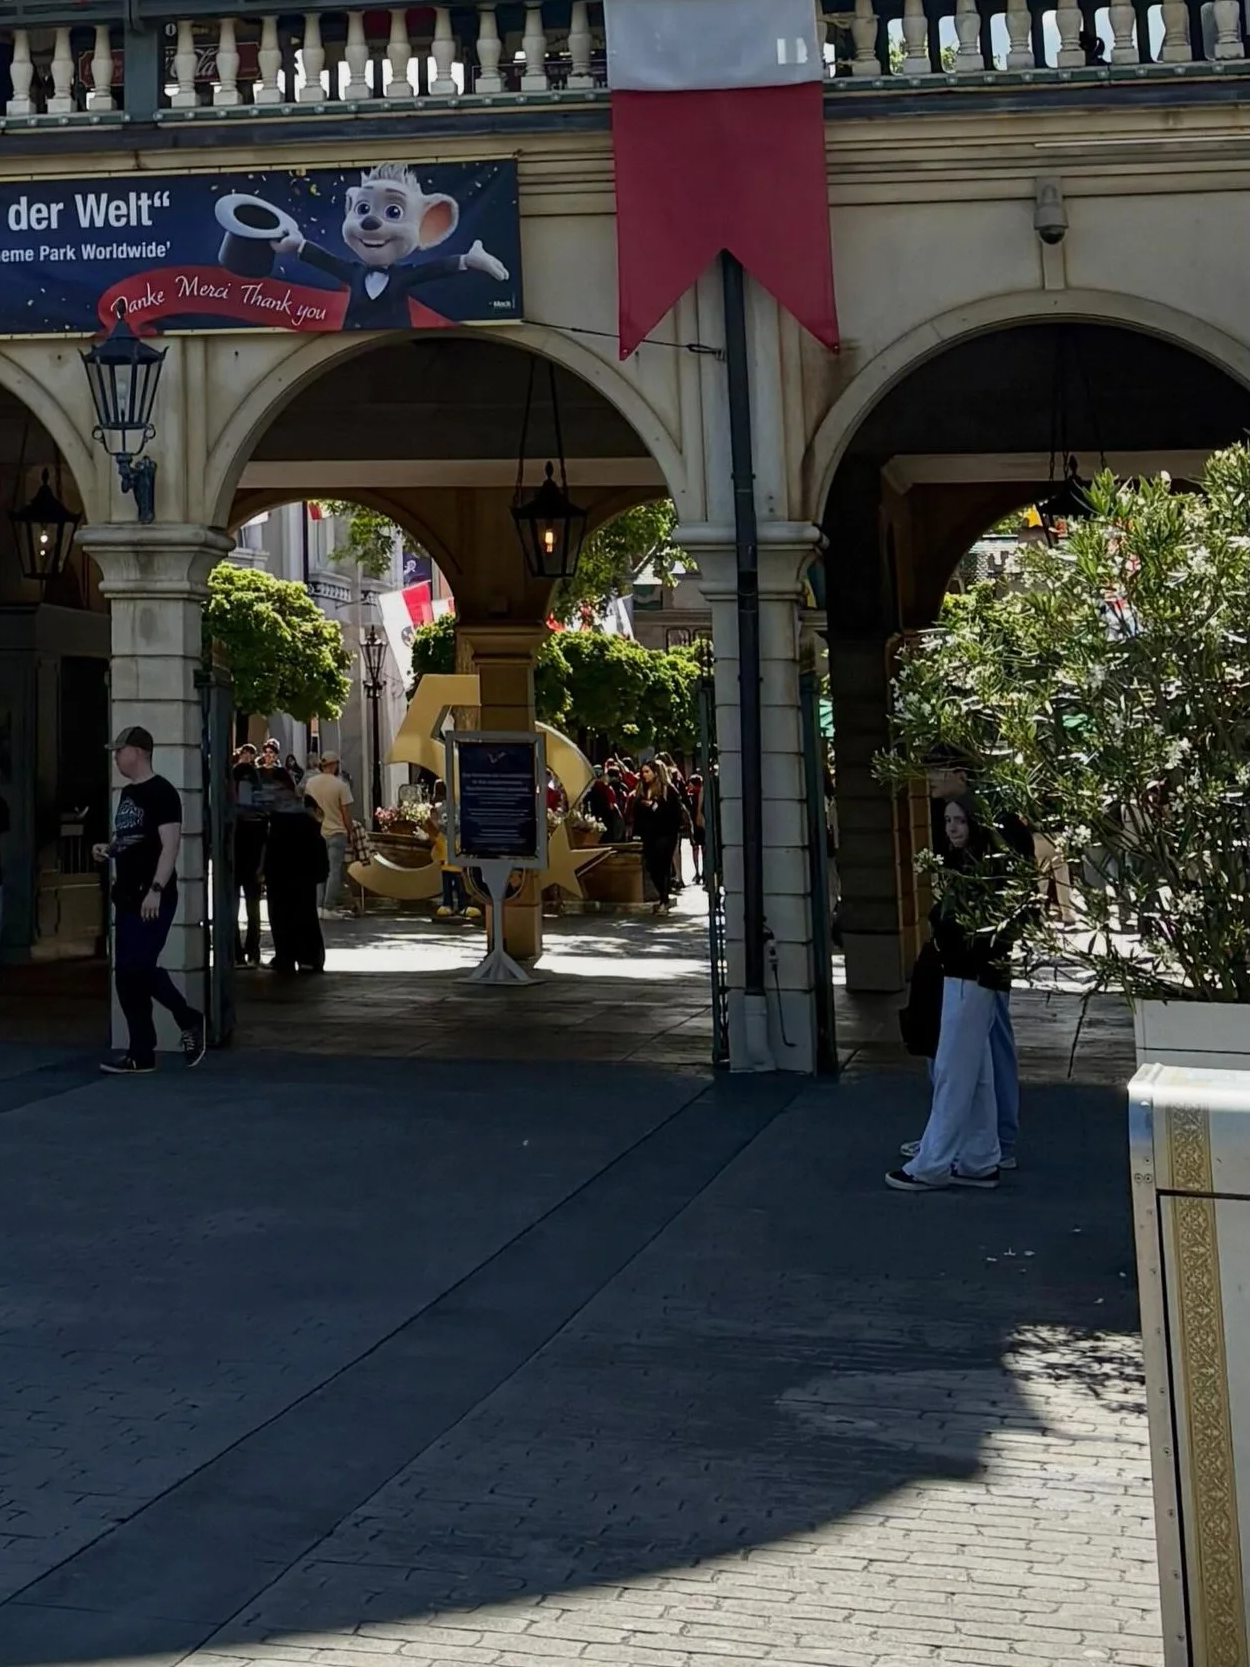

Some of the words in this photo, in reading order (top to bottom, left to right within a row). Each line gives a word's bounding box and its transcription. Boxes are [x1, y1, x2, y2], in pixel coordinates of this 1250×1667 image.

[8, 196, 64, 231] der
[75, 190, 170, 228] Welt“
[39, 244, 76, 261] Park
[175, 275, 231, 299] Merci
[241, 283, 291, 314] Thank
[291, 306, 327, 326] you
